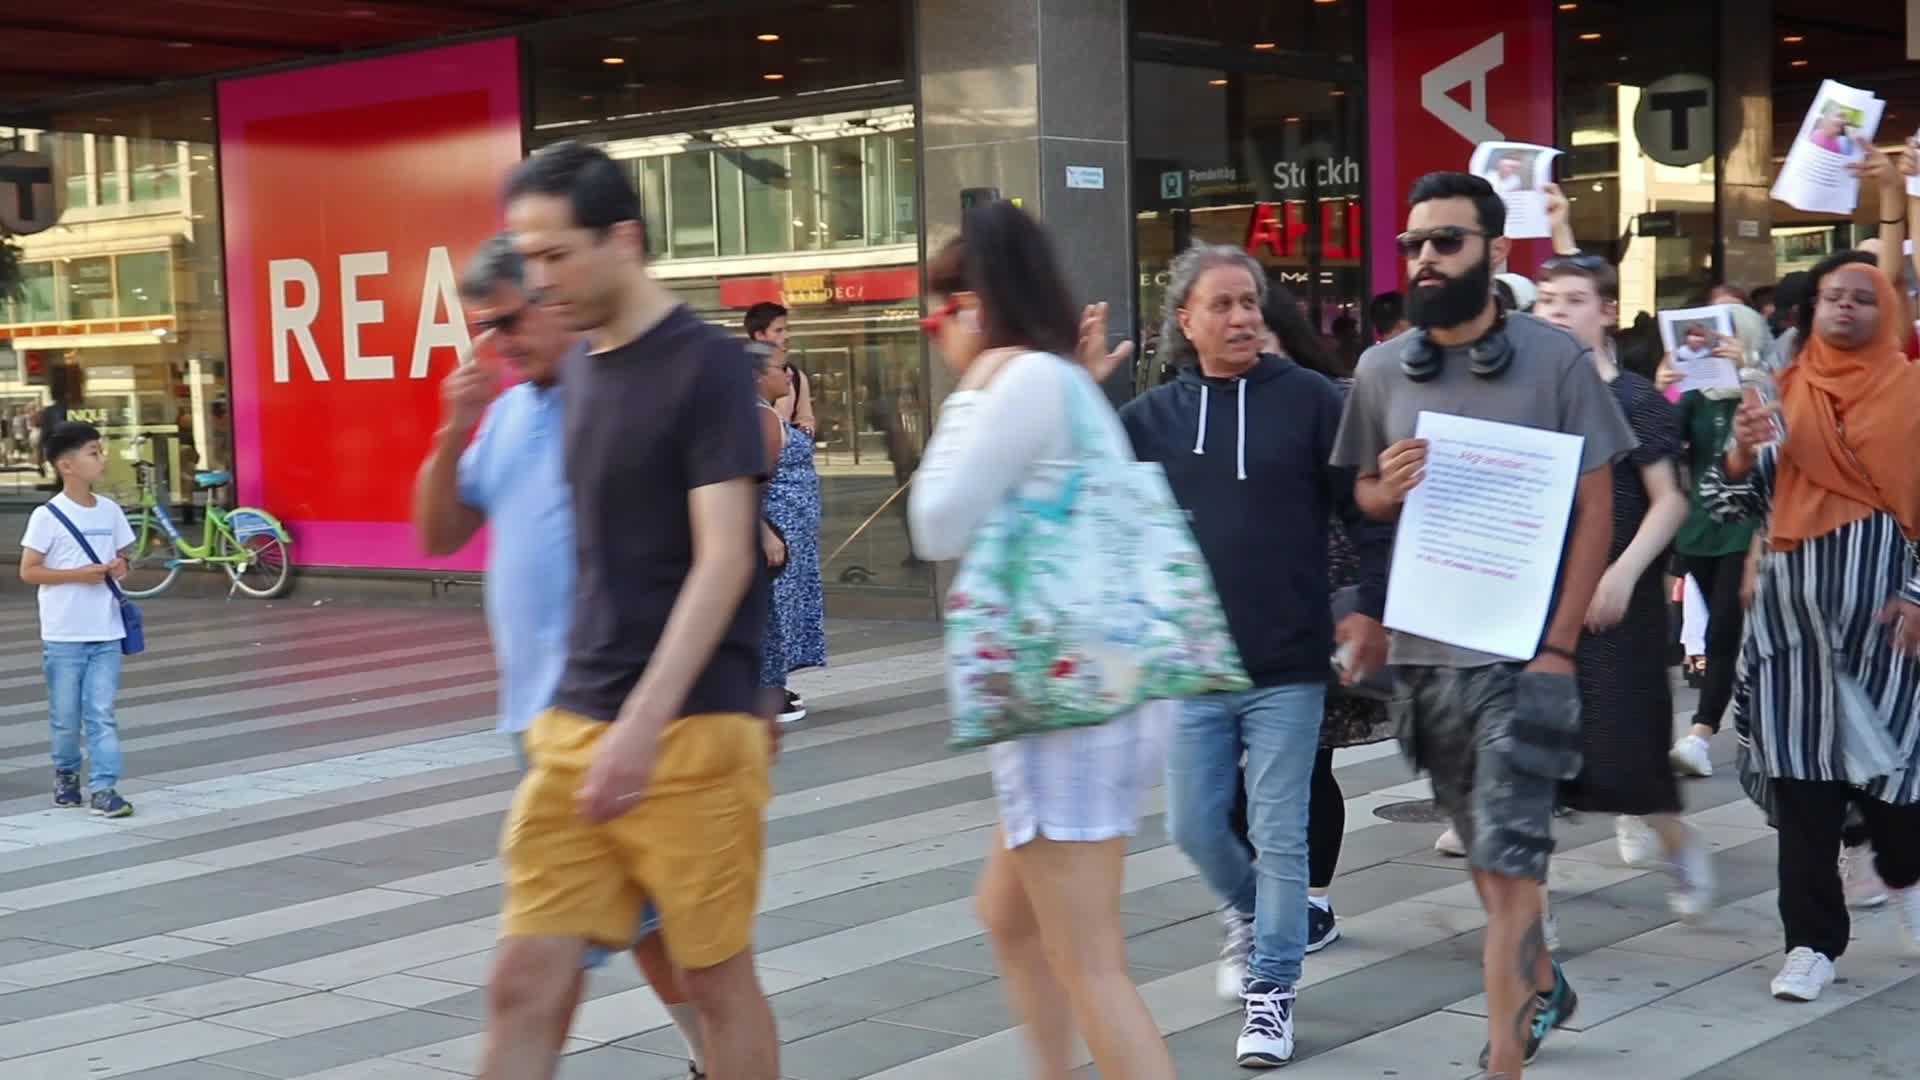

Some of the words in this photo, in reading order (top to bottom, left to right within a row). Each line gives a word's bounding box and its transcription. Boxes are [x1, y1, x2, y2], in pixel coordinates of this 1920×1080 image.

[1650, 89, 1708, 150] T
[0, 167, 50, 220] T
[268, 246, 473, 383] REA
